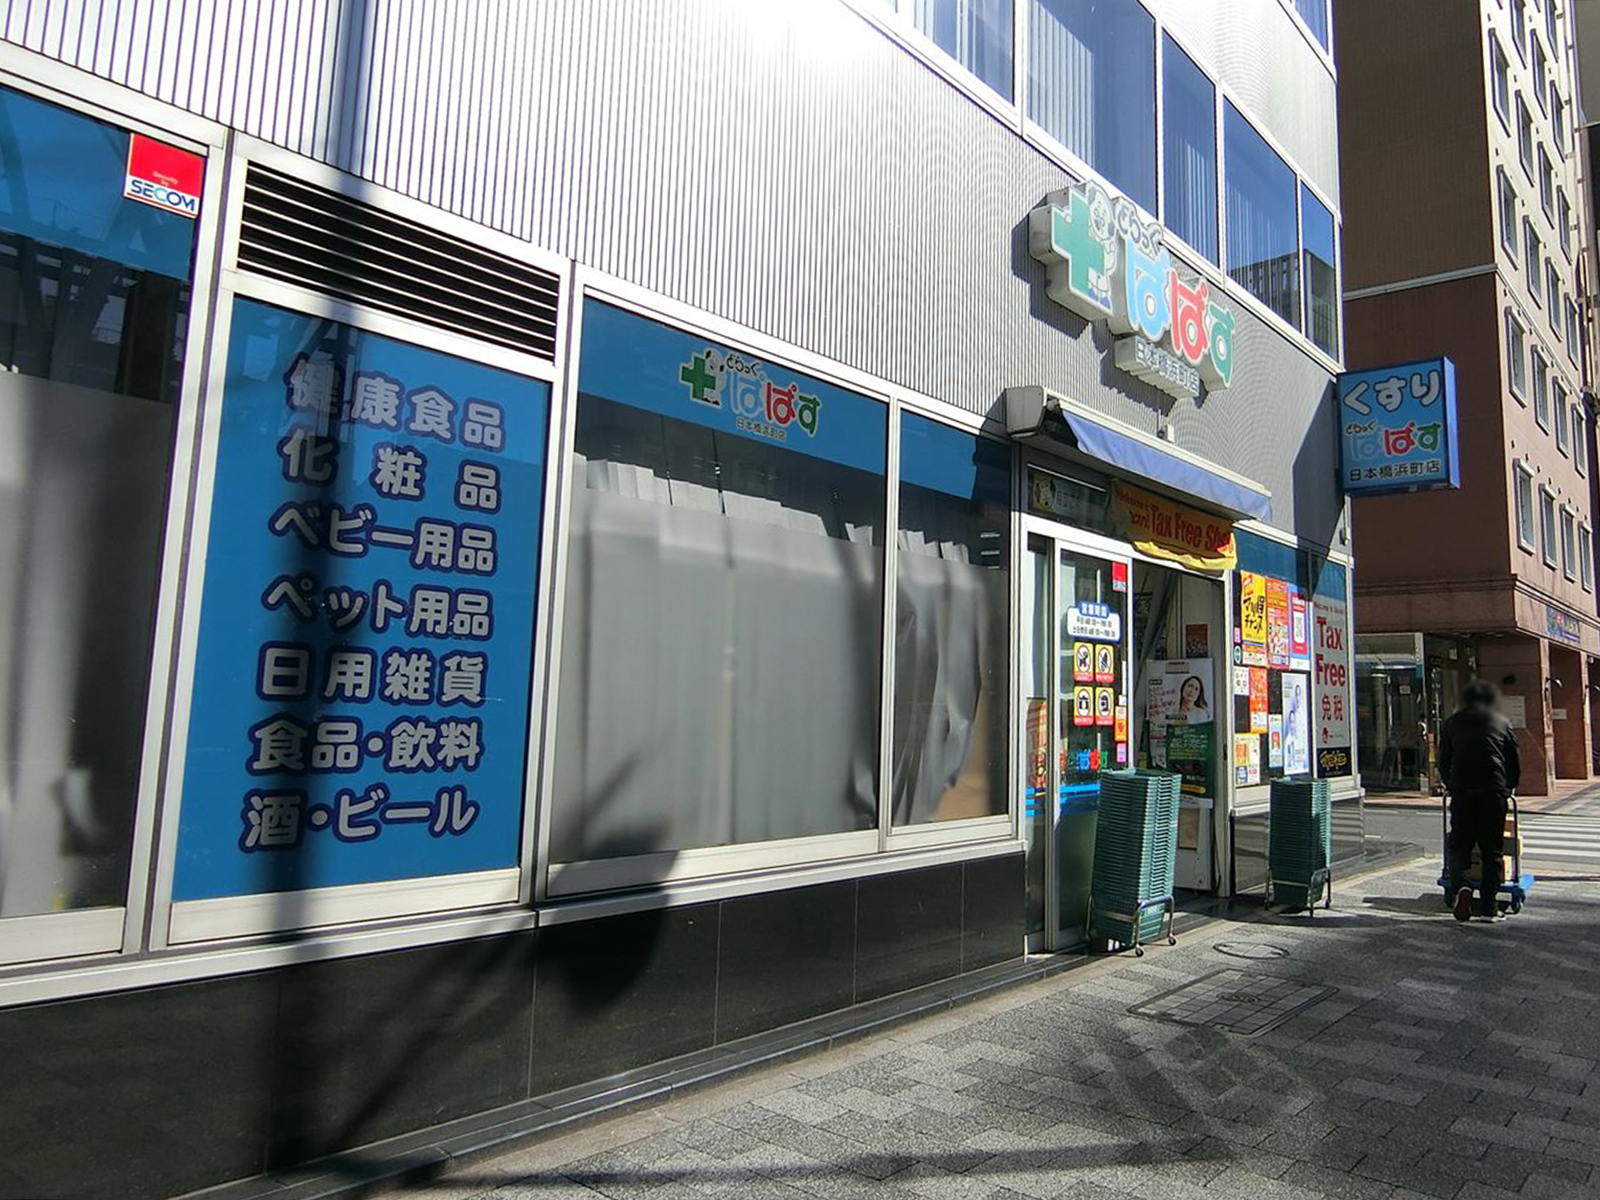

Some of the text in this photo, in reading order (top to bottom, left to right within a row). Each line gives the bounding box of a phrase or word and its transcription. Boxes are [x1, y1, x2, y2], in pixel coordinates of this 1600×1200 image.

[131, 180, 194, 211] SECOM
[287, 356, 504, 448] 健康食品
[731, 373, 821, 435] ぱぱす
[1344, 370, 1440, 415] くすり
[281, 427, 500, 512] 化粧品
[1350, 461, 1440, 480] 日本橋浜町店
[271, 504, 498, 574] ベビー用品
[1150, 504, 1172, 538] Tax
[1175, 512, 1202, 547] Free
[264, 577, 492, 638] ペット用品
[1317, 615, 1343, 651] Tax
[260, 644, 486, 704] 日用雑貨
[1316, 654, 1346, 687] Free
[1322, 695, 1343, 721] 免税
[250, 715, 482, 775] 食品・飲料
[241, 787, 477, 853] 酒・ビール
